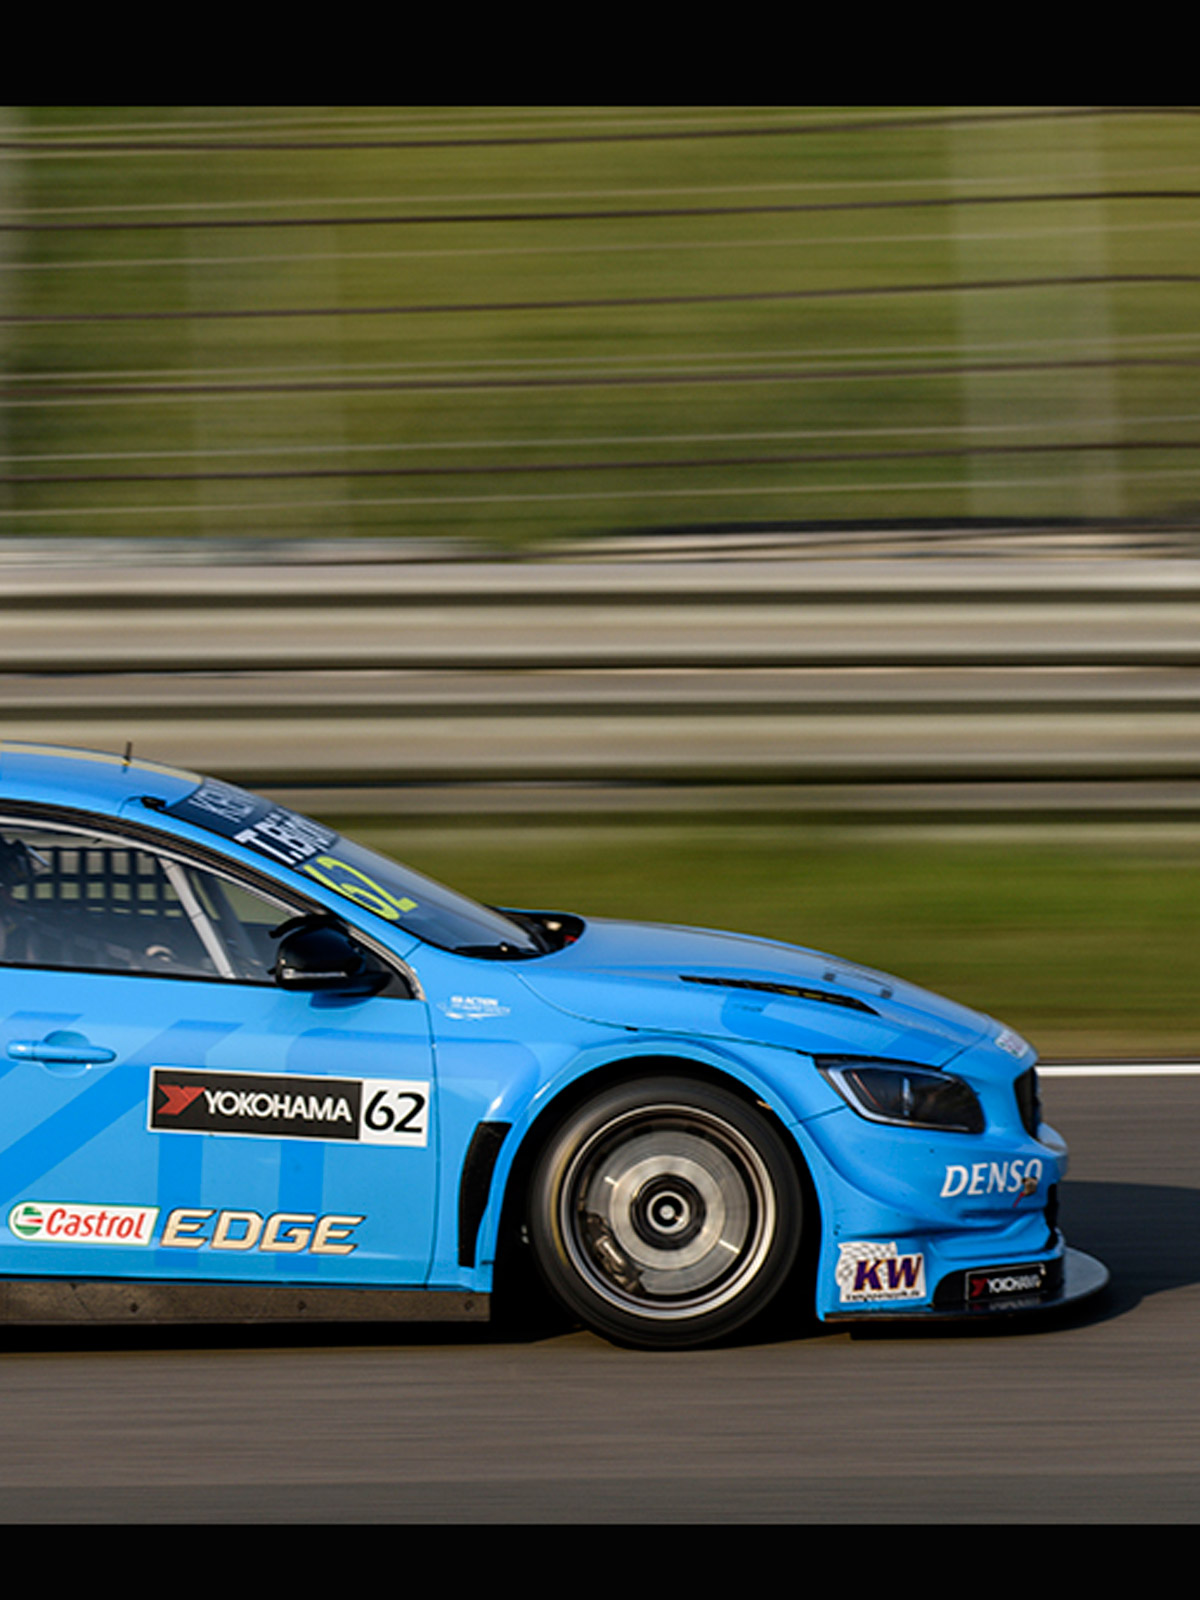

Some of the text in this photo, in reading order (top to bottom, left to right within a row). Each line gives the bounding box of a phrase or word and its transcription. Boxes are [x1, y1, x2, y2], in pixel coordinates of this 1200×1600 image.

[303, 856, 418, 920] 62
[204, 1090, 426, 1133] YOKOHAMA 62
[46, 1208, 367, 1256] Castrol EDGE
[853, 1255, 923, 1292] KW
